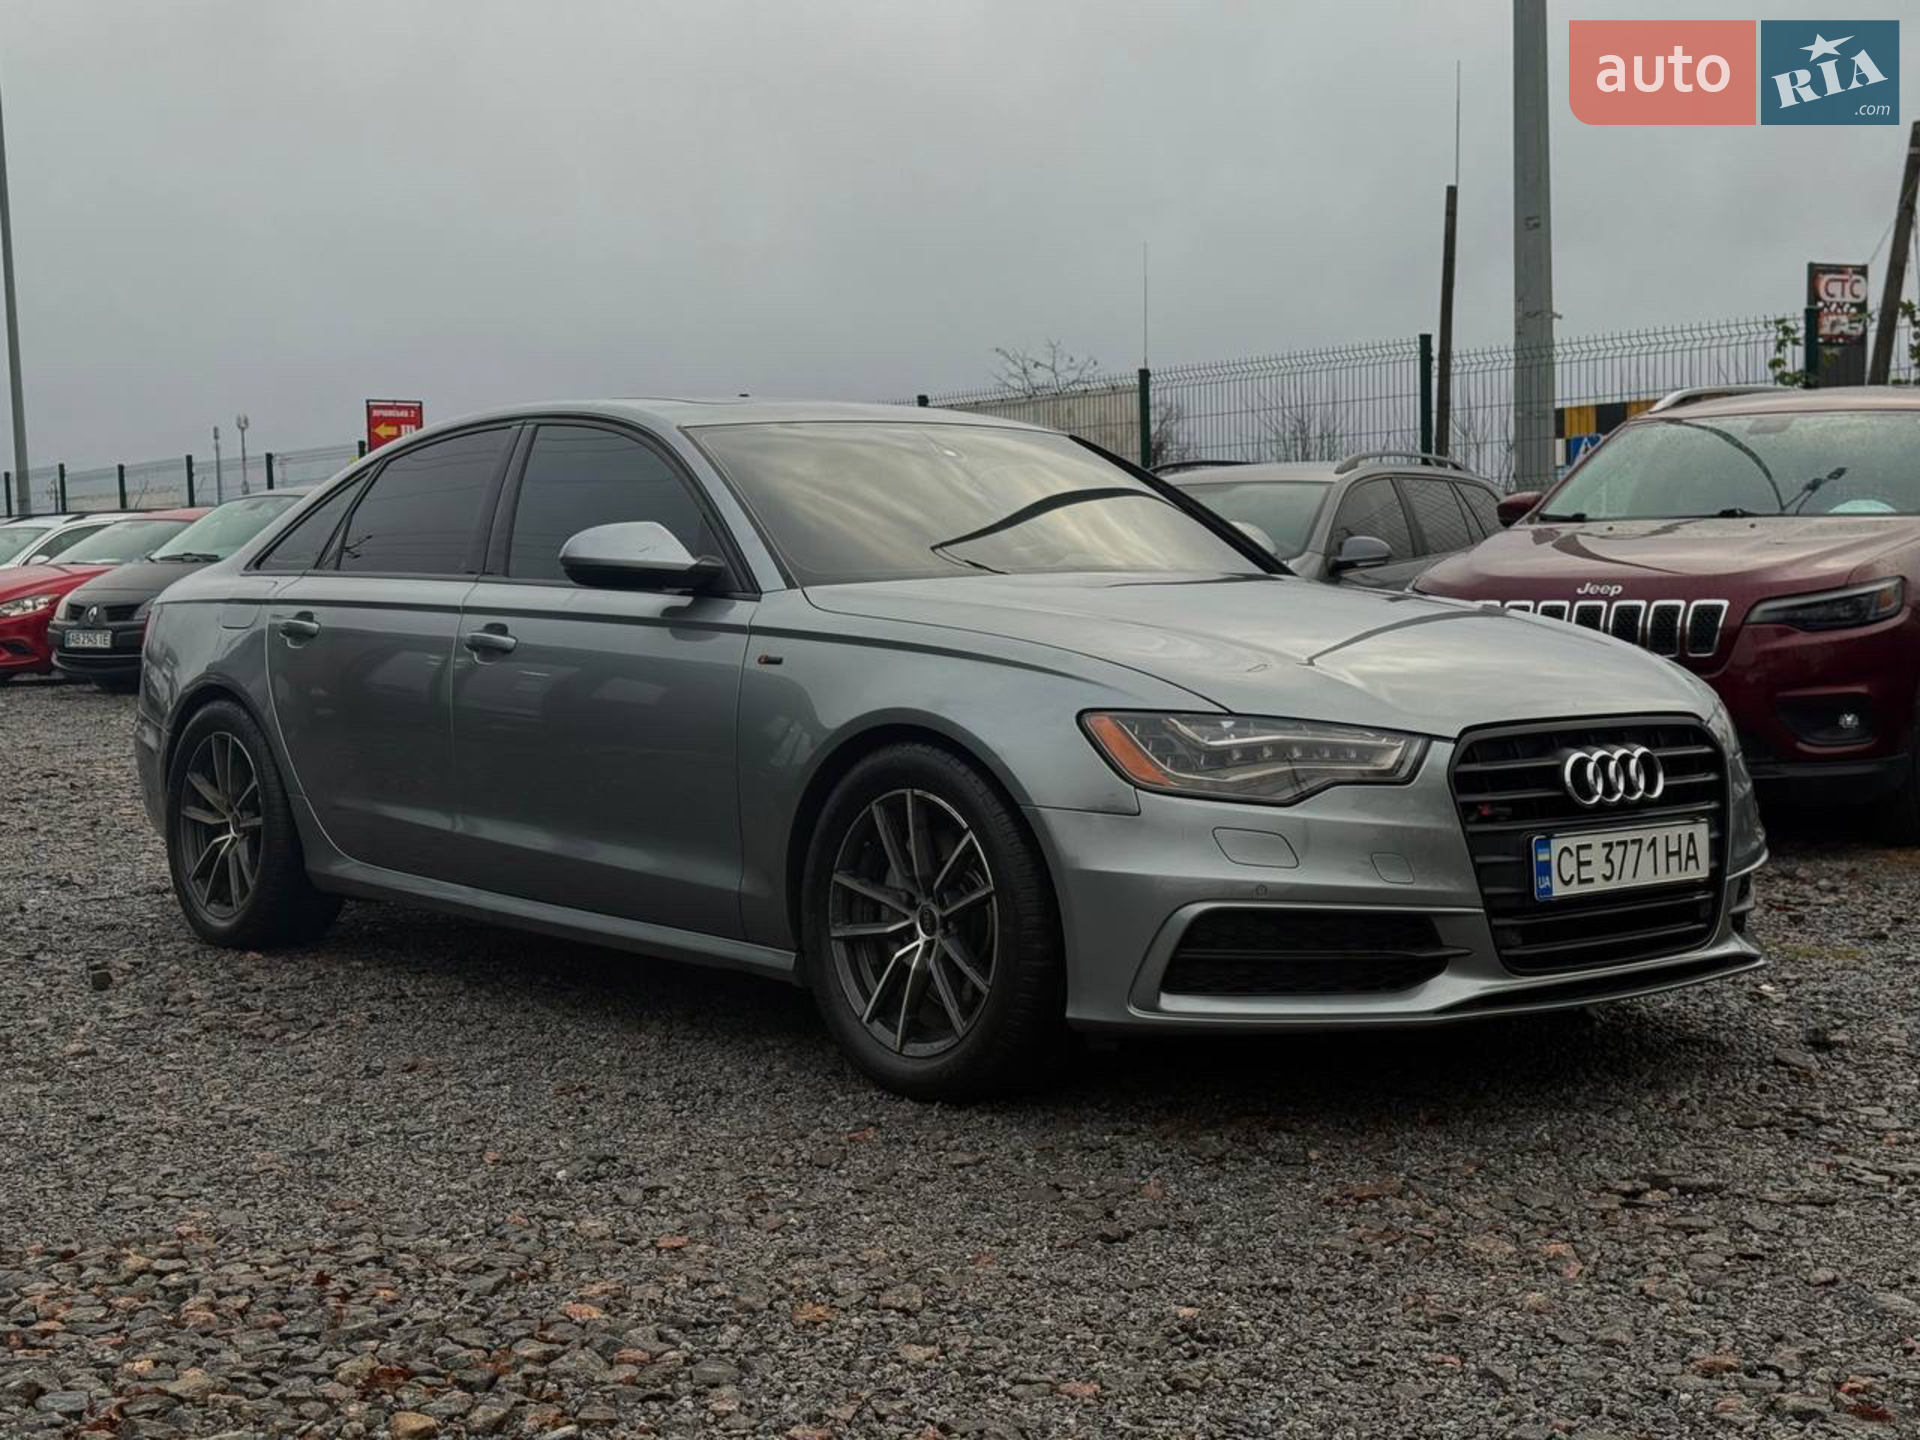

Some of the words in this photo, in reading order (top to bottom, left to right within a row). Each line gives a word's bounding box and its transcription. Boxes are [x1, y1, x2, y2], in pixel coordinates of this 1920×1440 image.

[1576, 582, 1623, 597] Jeep
[1557, 843, 1595, 887] CE
[1601, 836, 1658, 882] 3771
[1665, 832, 1700, 875] HA
[1538, 875, 1551, 889] UA
